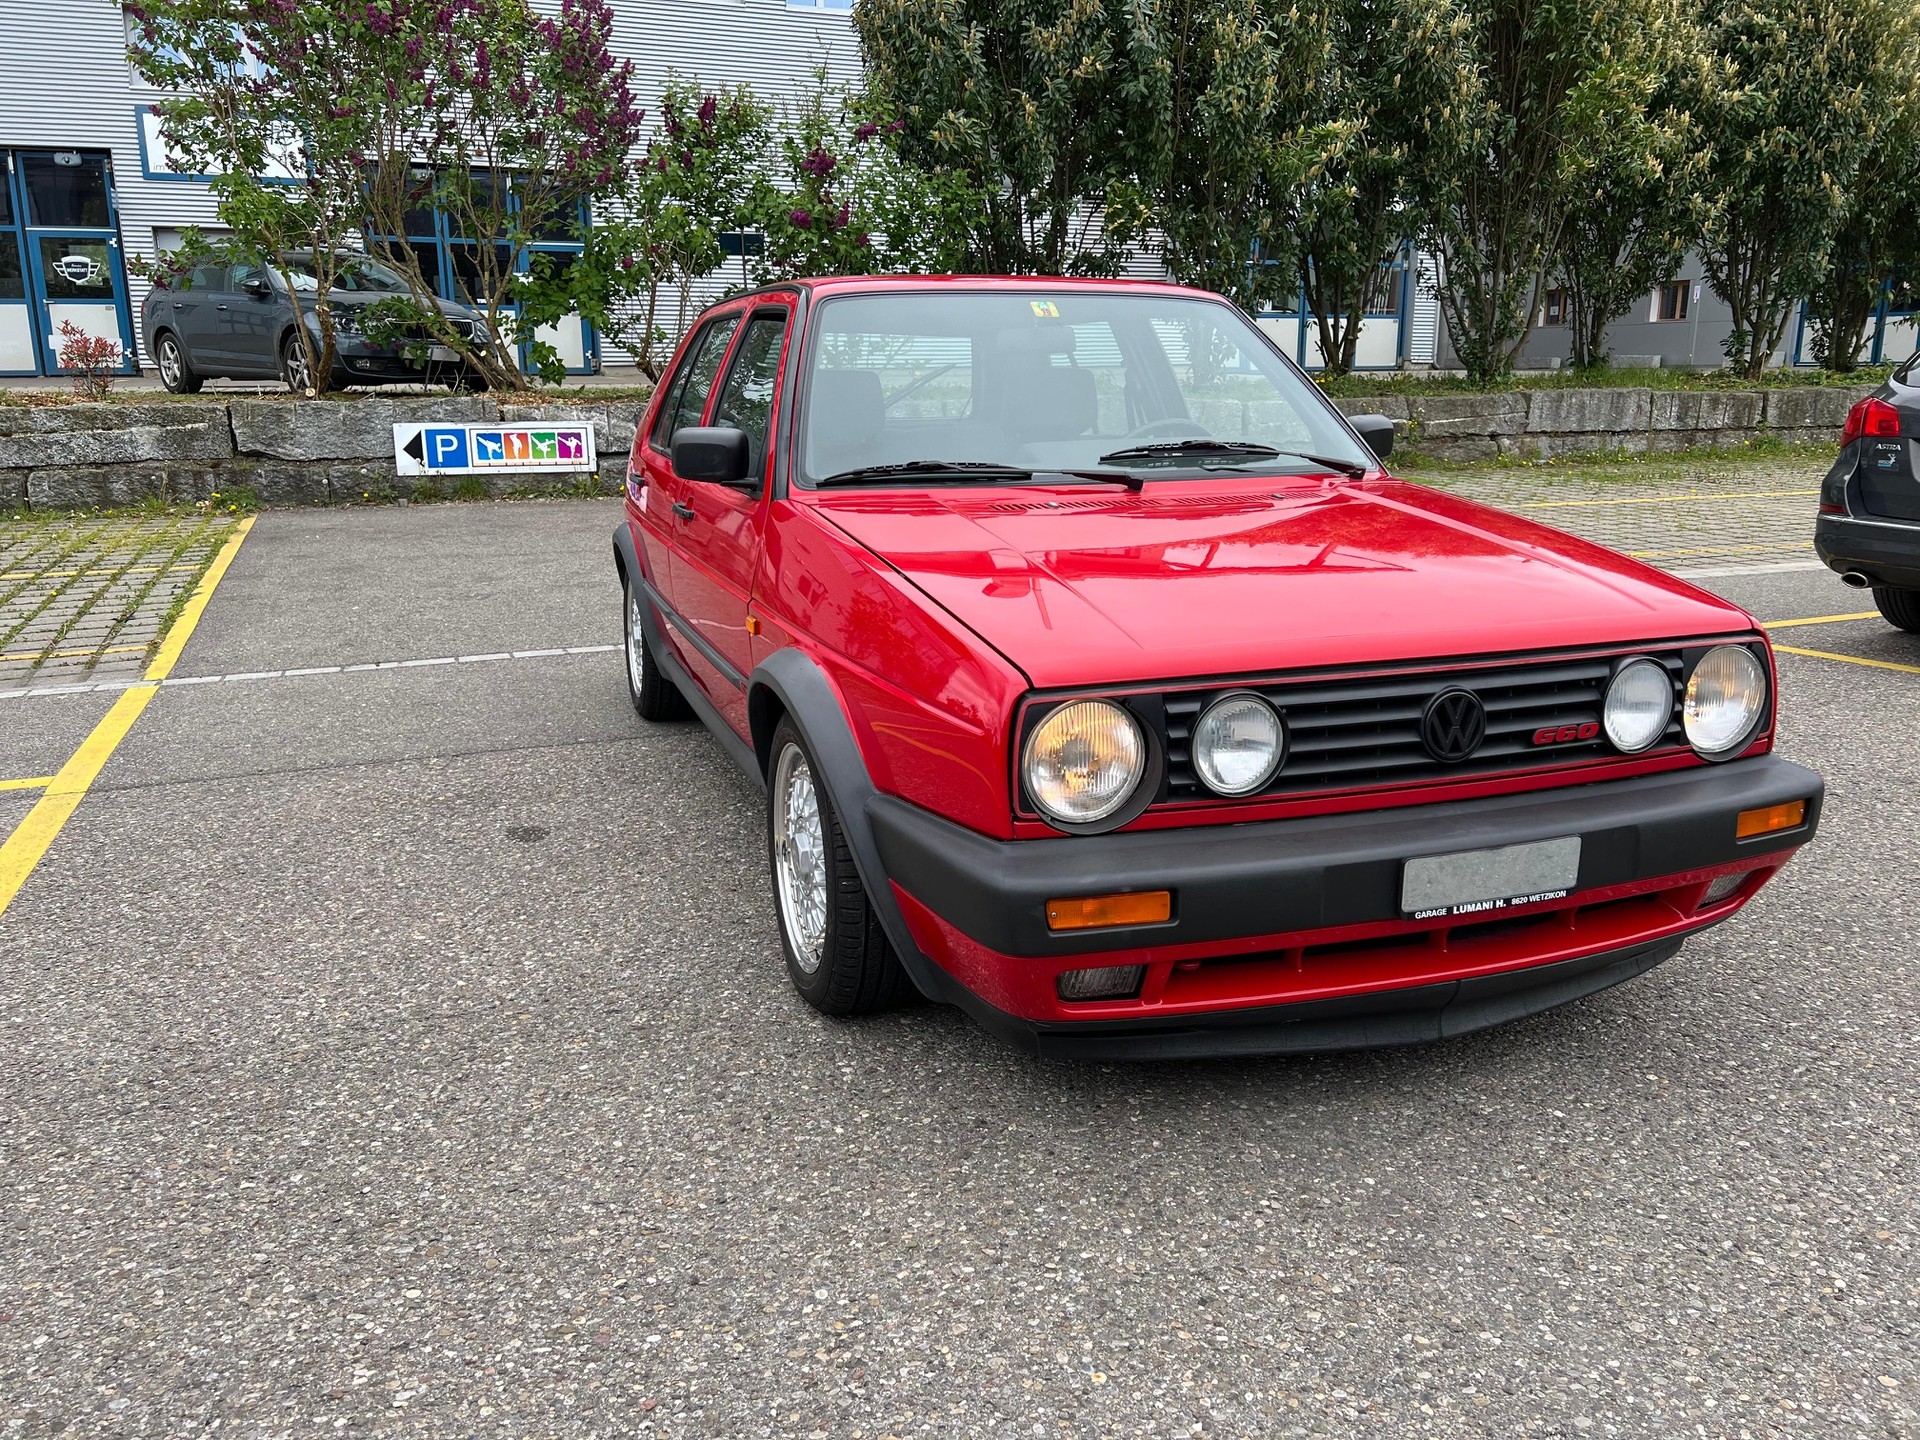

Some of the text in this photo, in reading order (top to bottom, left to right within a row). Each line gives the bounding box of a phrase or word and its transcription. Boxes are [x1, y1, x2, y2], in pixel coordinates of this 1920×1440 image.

[435, 434, 458, 463] P
[1875, 443, 1902, 451] ASTRA
[1428, 692, 1484, 758] VW
[1533, 722, 1600, 745] G60
[1415, 890, 1567, 920] GARAGE LUMANI H. 8620 WETZIKON
